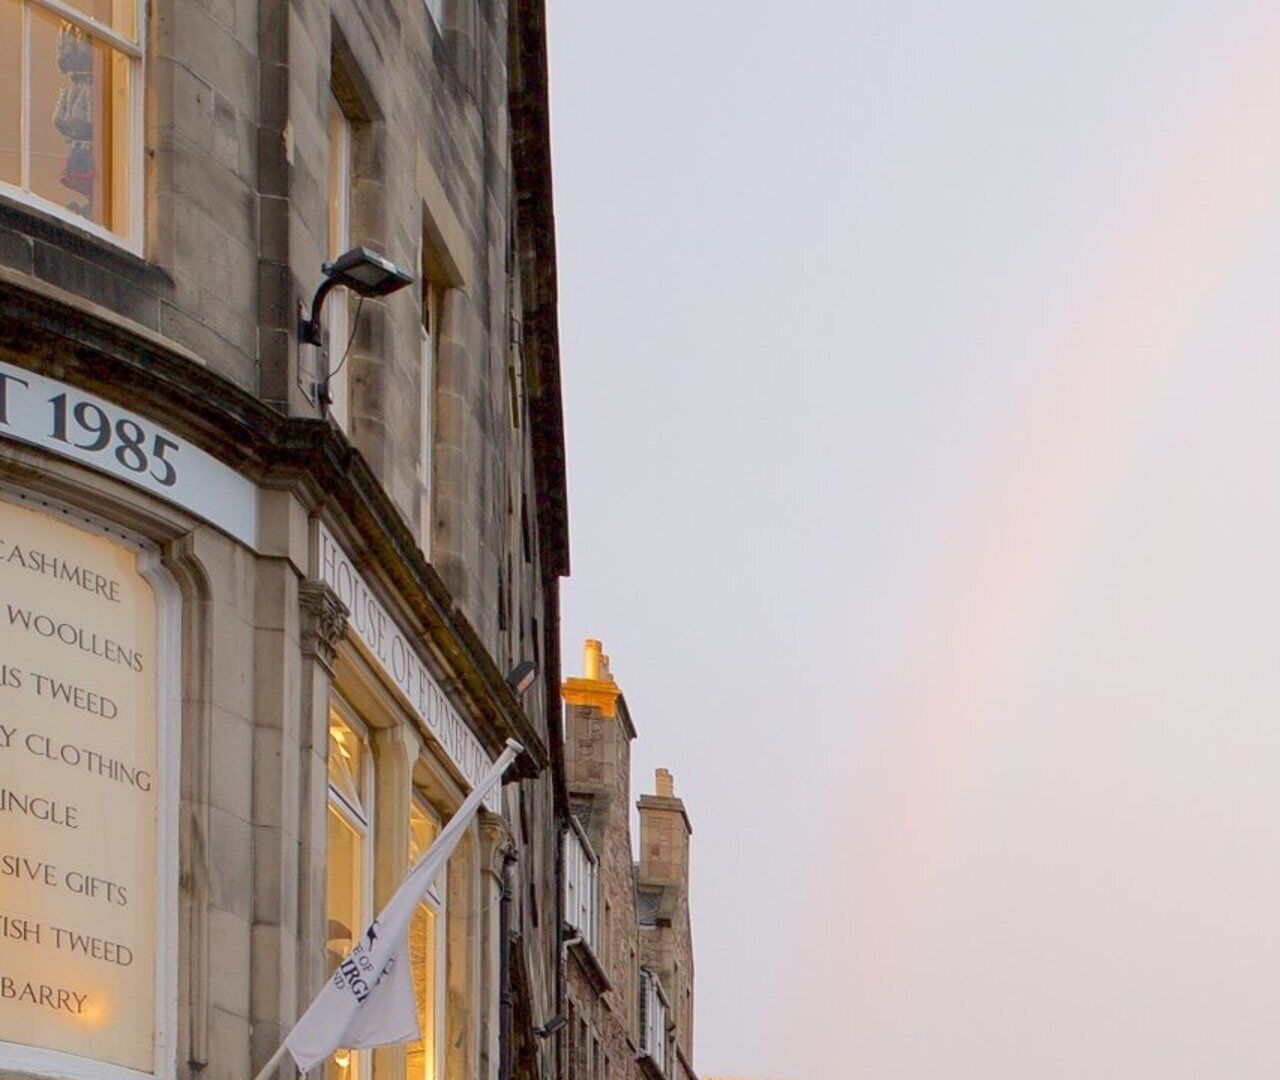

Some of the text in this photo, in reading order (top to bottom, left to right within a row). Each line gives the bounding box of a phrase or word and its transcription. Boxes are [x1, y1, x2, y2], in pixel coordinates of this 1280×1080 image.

[48, 392, 179, 486] 1985
[0, 540, 121, 604] ASHMERE
[7, 604, 144, 673] WOOLLENS
[322, 533, 388, 663] HOUSE
[390, 635, 415, 698] OF
[0, 664, 118, 720] IS TWEED
[25, 733, 151, 792] CLOTHING
[0, 788, 79, 829] INGLE
[1, 855, 128, 907] SIVE GIFTS
[0, 915, 133, 967] ISH TWEED
[1, 976, 88, 1014] BARRY
